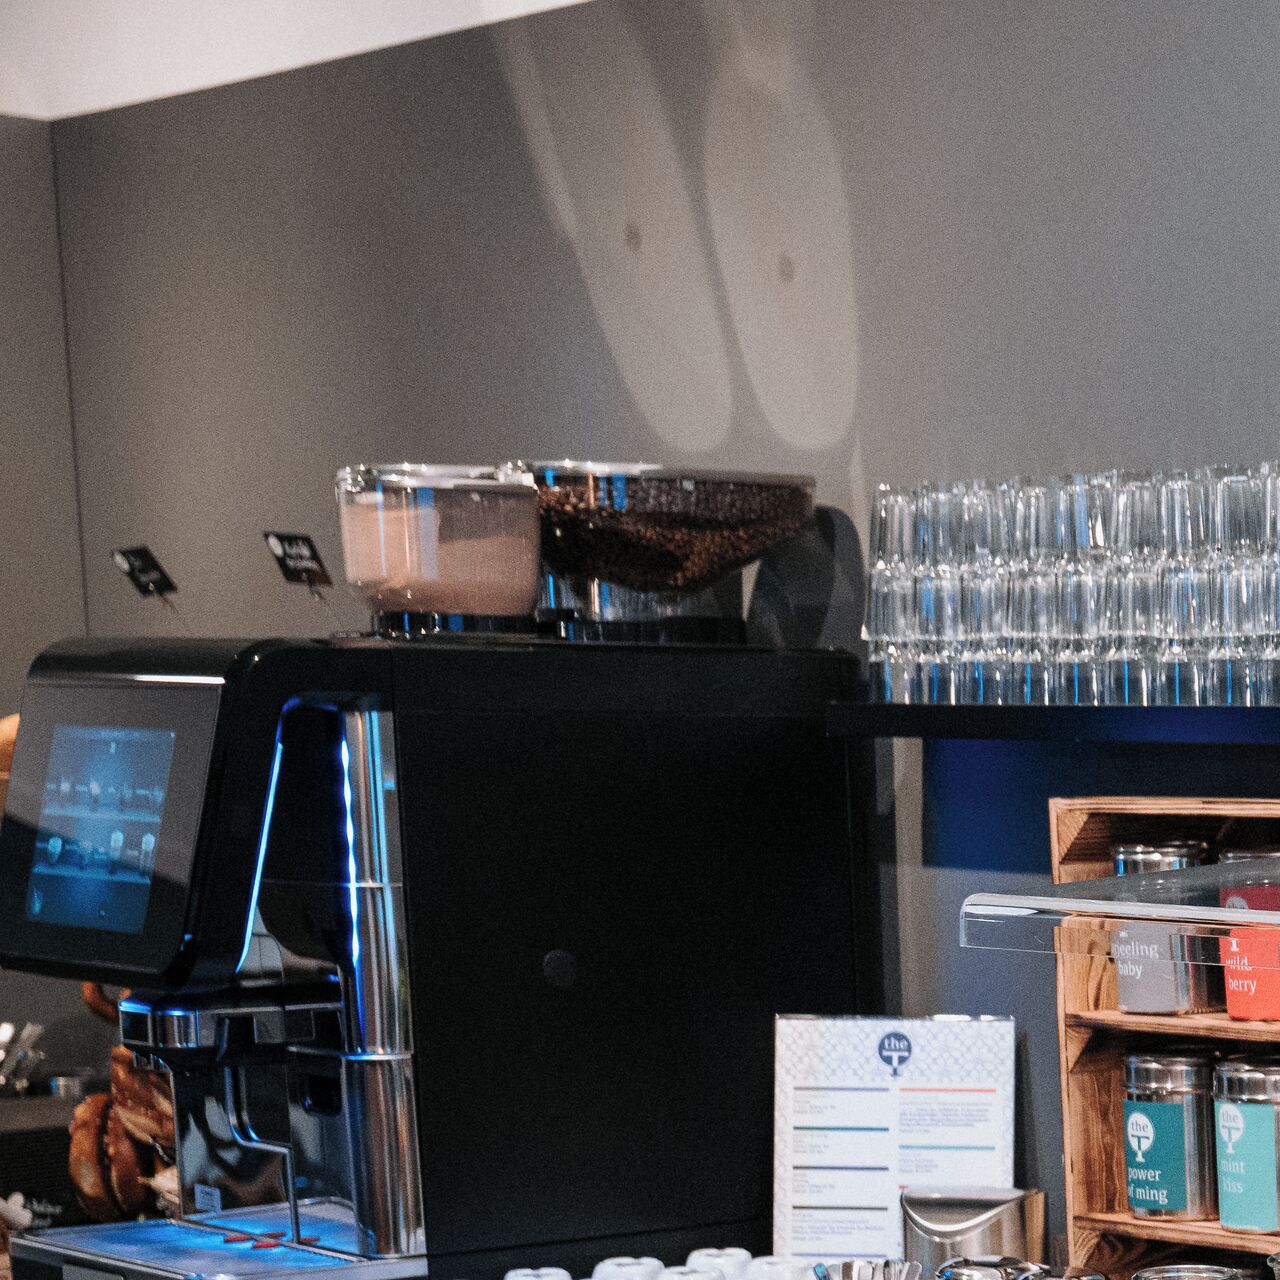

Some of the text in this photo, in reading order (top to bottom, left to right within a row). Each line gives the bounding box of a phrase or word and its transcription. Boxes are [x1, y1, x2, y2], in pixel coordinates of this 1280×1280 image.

[1118, 960, 1143, 979] baby
[1228, 976, 1257, 994] berry
[884, 1037, 908, 1050] the
[1221, 1109, 1239, 1123] the
[1131, 1119, 1149, 1133] the
[1220, 1160, 1245, 1173] mint
[1128, 1167, 1162, 1181] power
[1222, 1177, 1243, 1193] kiss
[1136, 1185, 1169, 1205] ming
